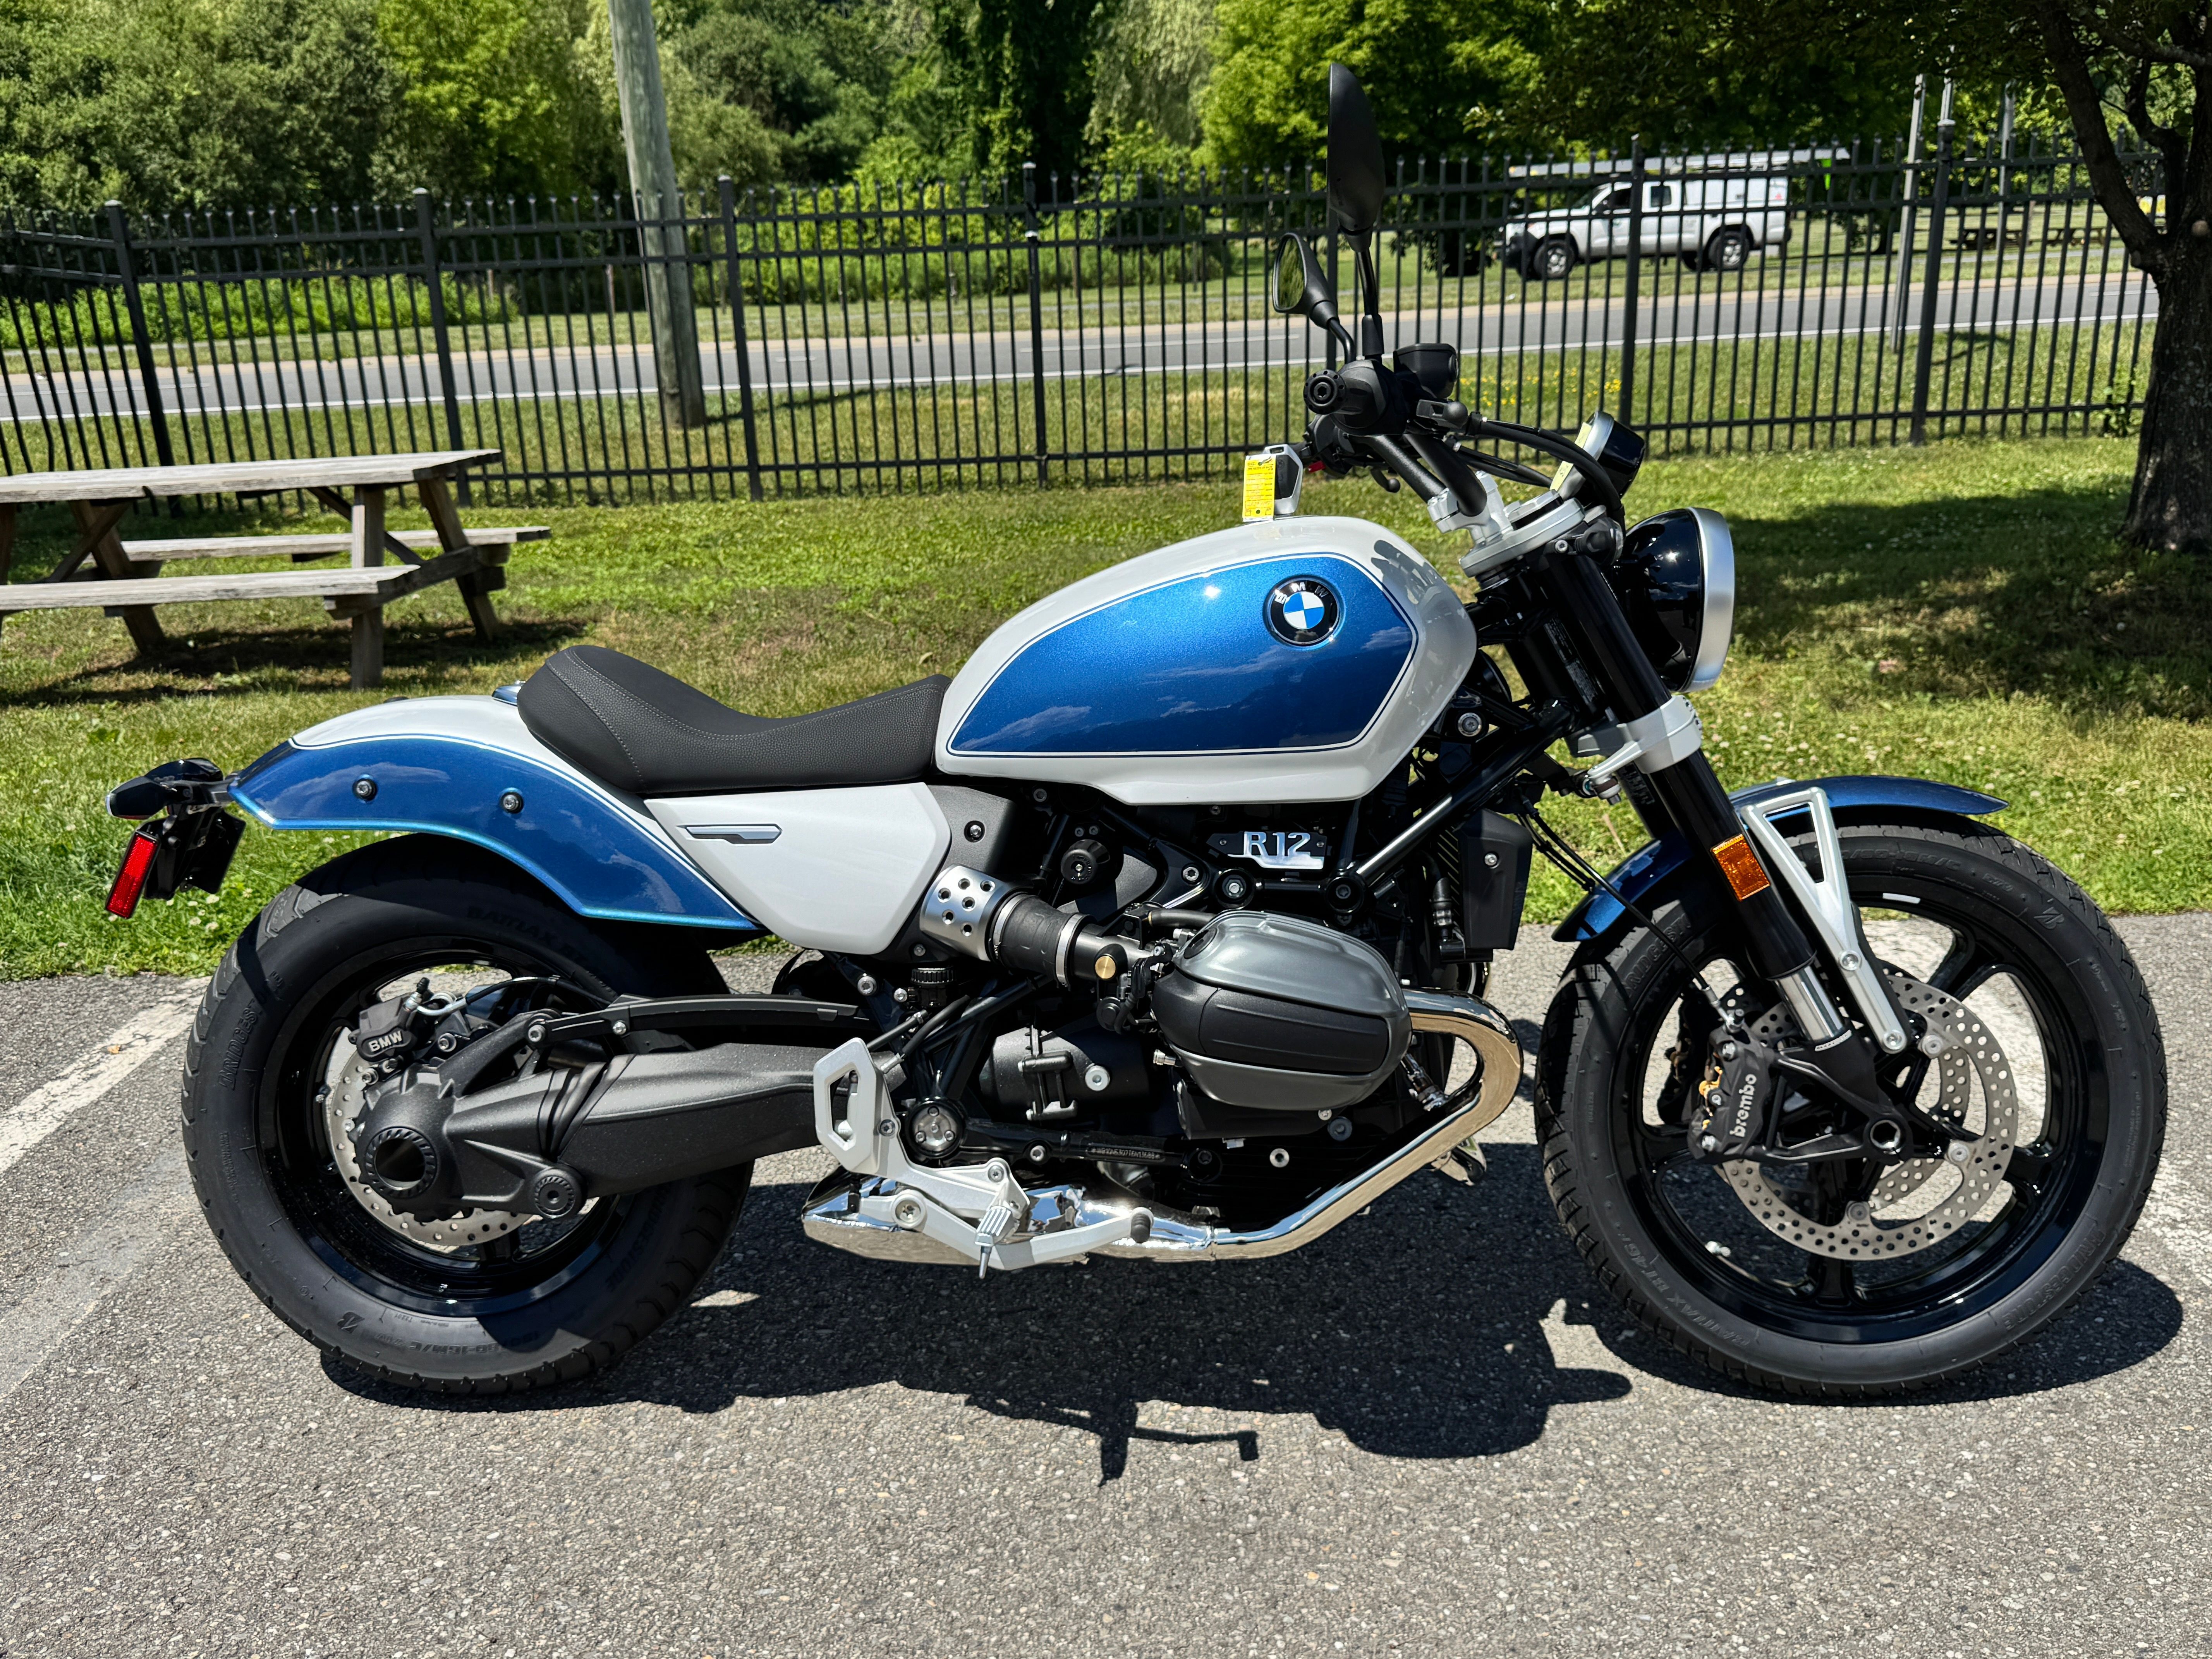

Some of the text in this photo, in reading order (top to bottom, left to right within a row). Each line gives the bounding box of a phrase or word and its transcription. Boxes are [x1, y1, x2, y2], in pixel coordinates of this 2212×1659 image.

[1274, 582, 1329, 605] BMW
[1243, 831, 1311, 857] R12
[368, 1030, 404, 1053] BMW
[1729, 1073, 1757, 1138] brembo
